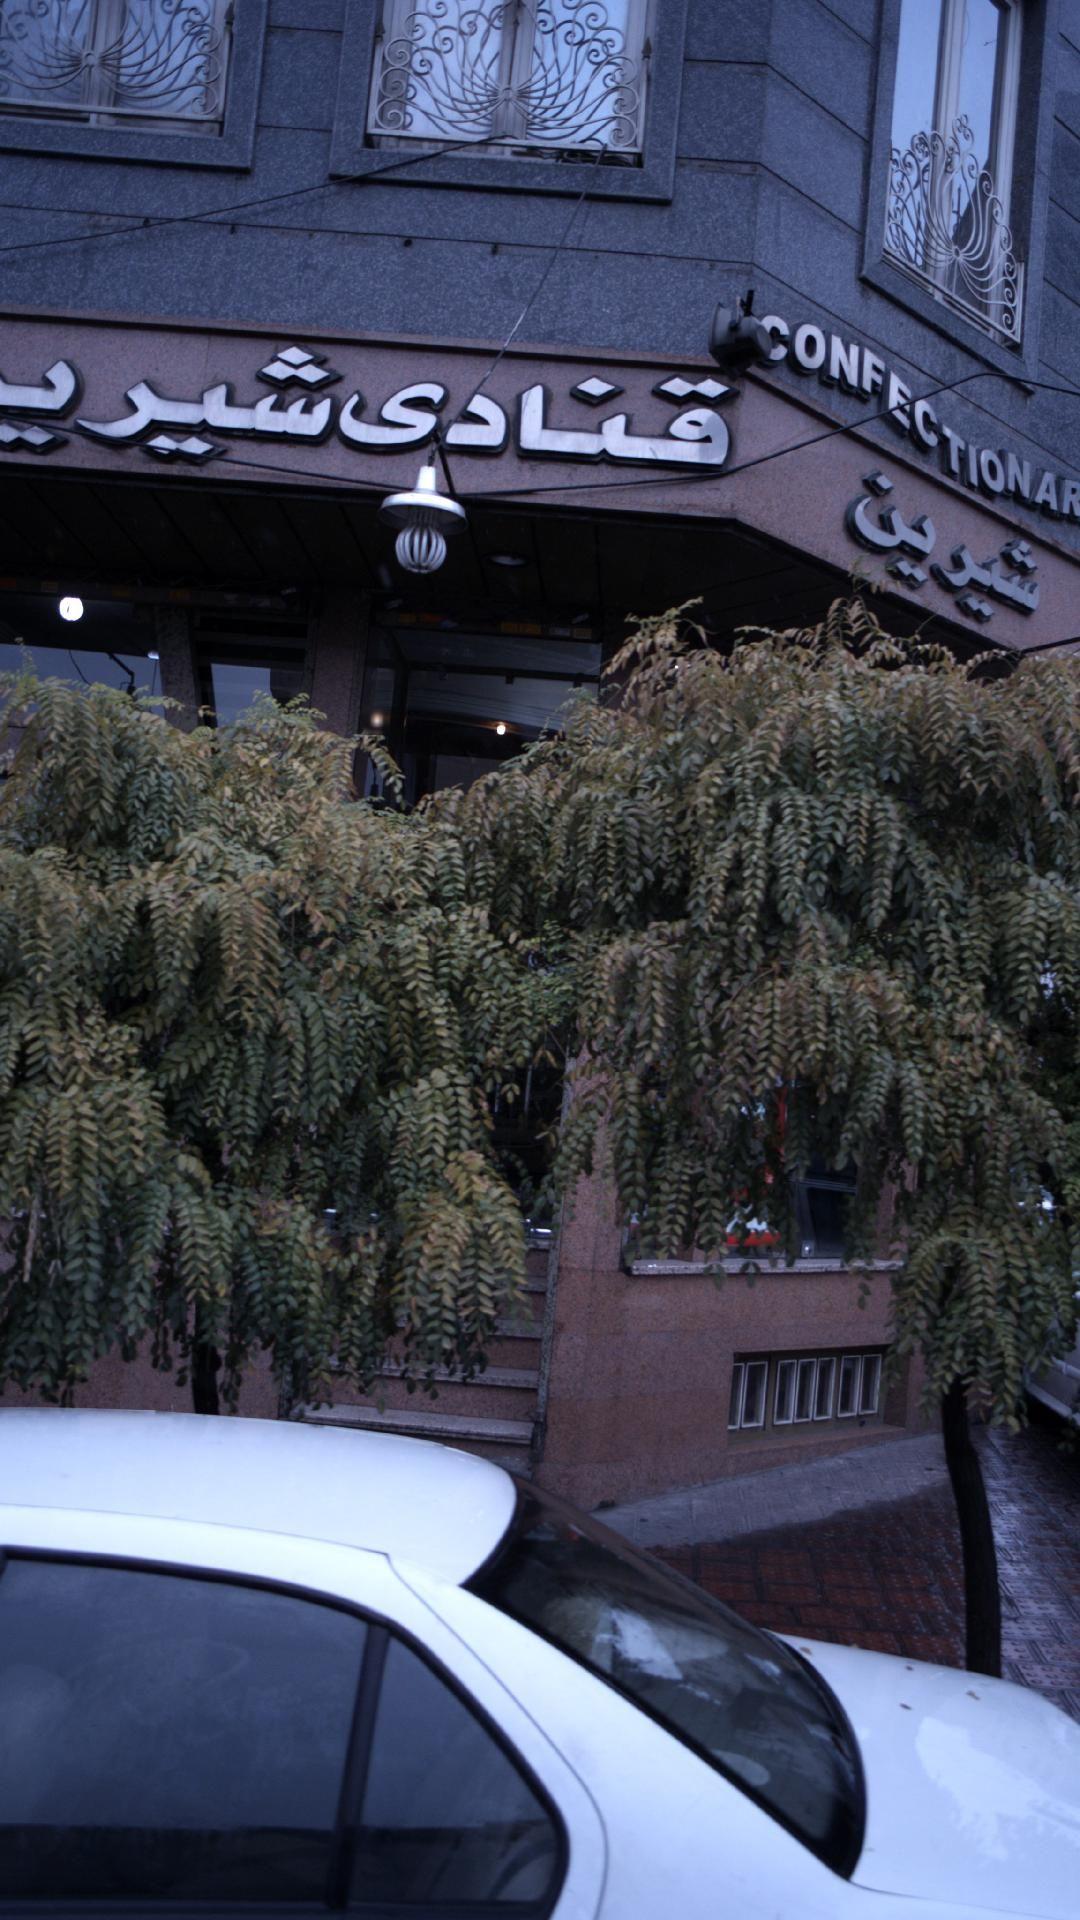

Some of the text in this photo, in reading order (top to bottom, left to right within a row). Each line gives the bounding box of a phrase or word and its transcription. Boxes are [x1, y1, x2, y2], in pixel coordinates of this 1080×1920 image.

[0, 346, 735, 467] قنادی شیری
[848, 473, 1041, 622] شیرین
